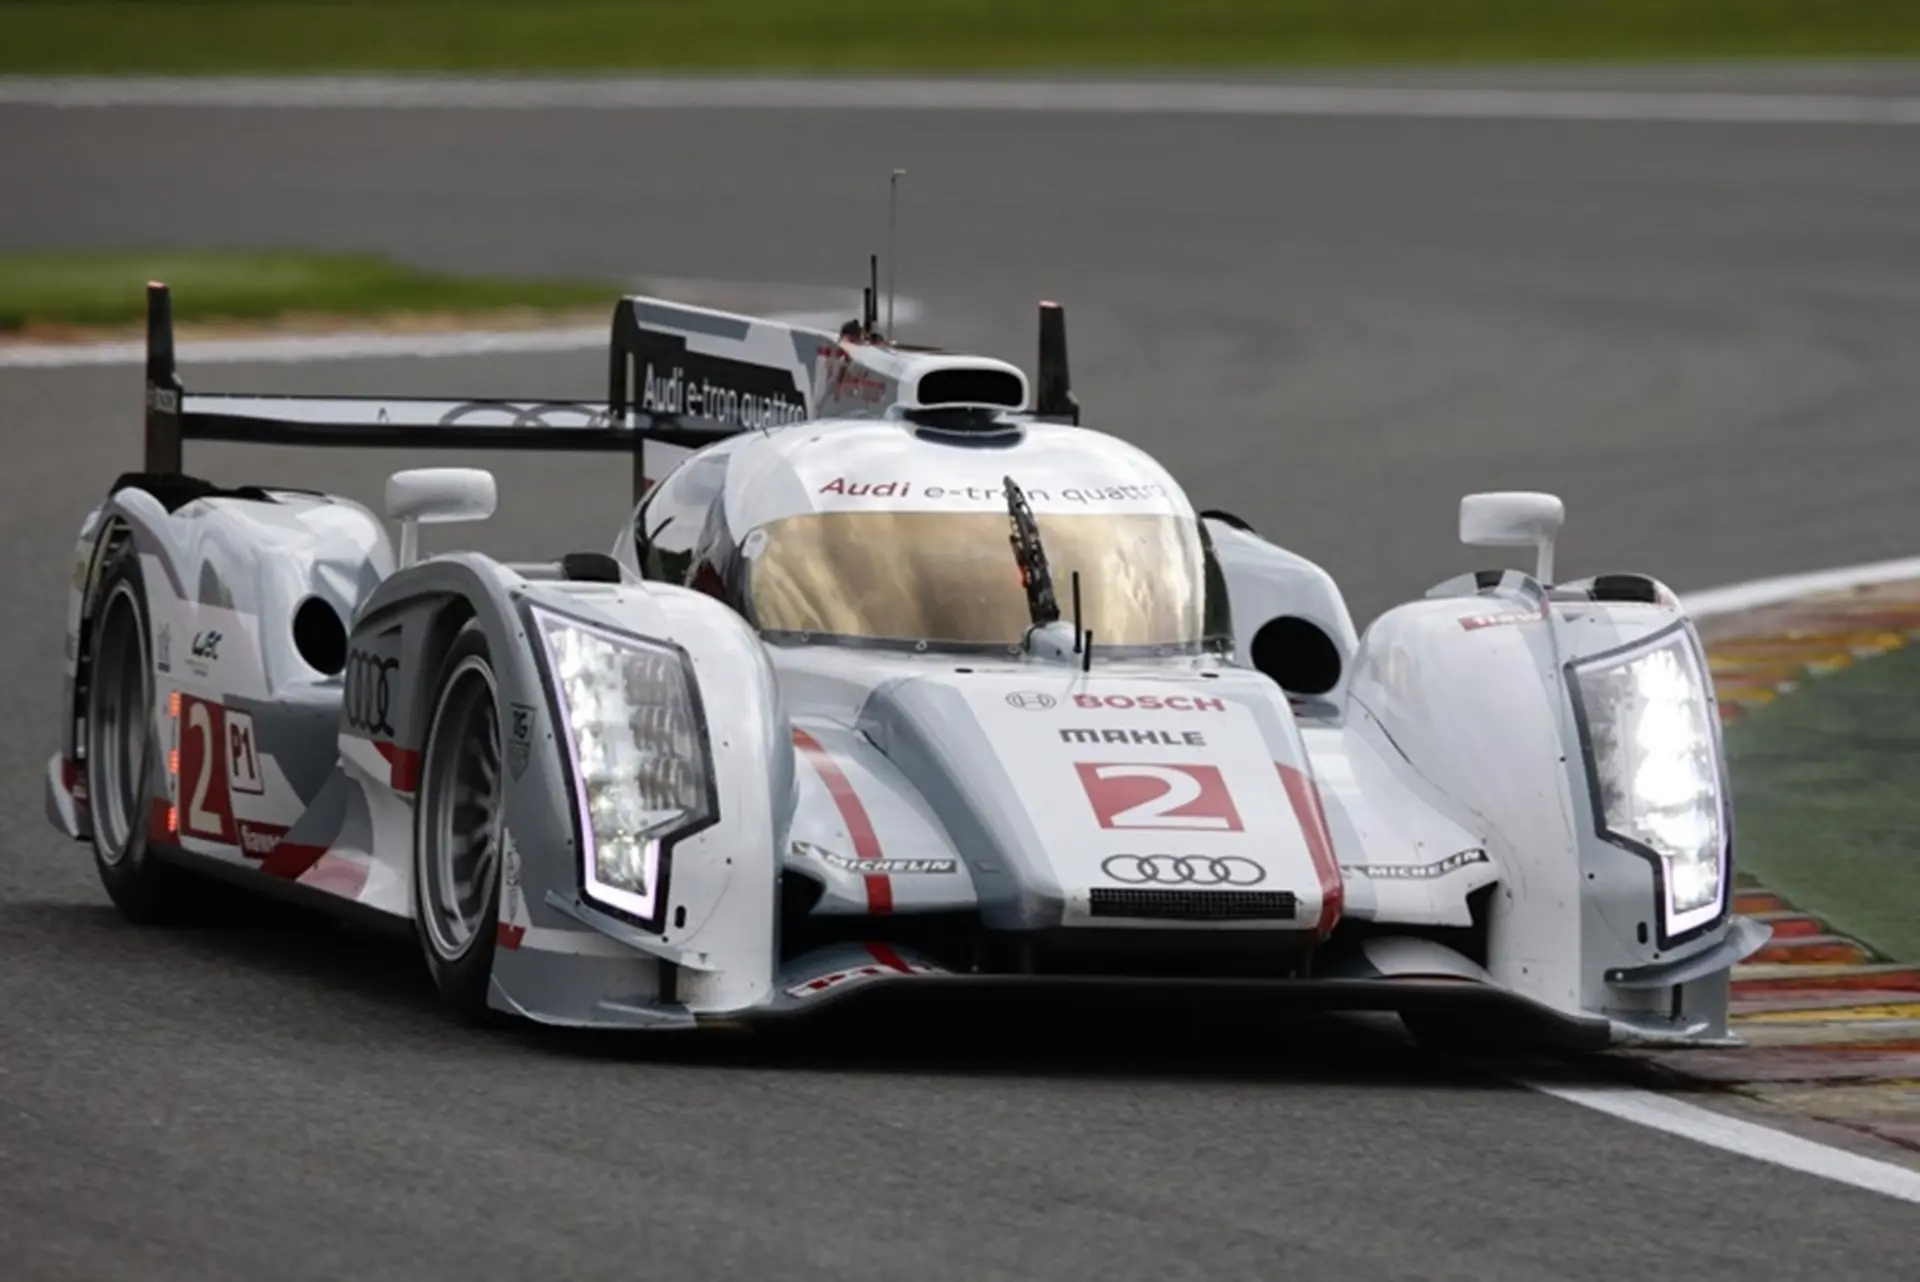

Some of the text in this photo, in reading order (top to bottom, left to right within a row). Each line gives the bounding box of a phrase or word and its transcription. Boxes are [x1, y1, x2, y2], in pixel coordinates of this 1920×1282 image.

[643, 362, 684, 414] Audi
[686, 376, 738, 423] e-tron
[819, 476, 912, 498] Audi
[924, 484, 1050, 502] e-trn
[1072, 694, 1226, 712] BOSCH
[1058, 728, 1207, 747] MAHLE
[189, 702, 255, 835] 2 P1
[1095, 765, 1230, 829] 2
[824, 853, 953, 872] MICHELIN
[1367, 850, 1480, 877] MICHELIN
